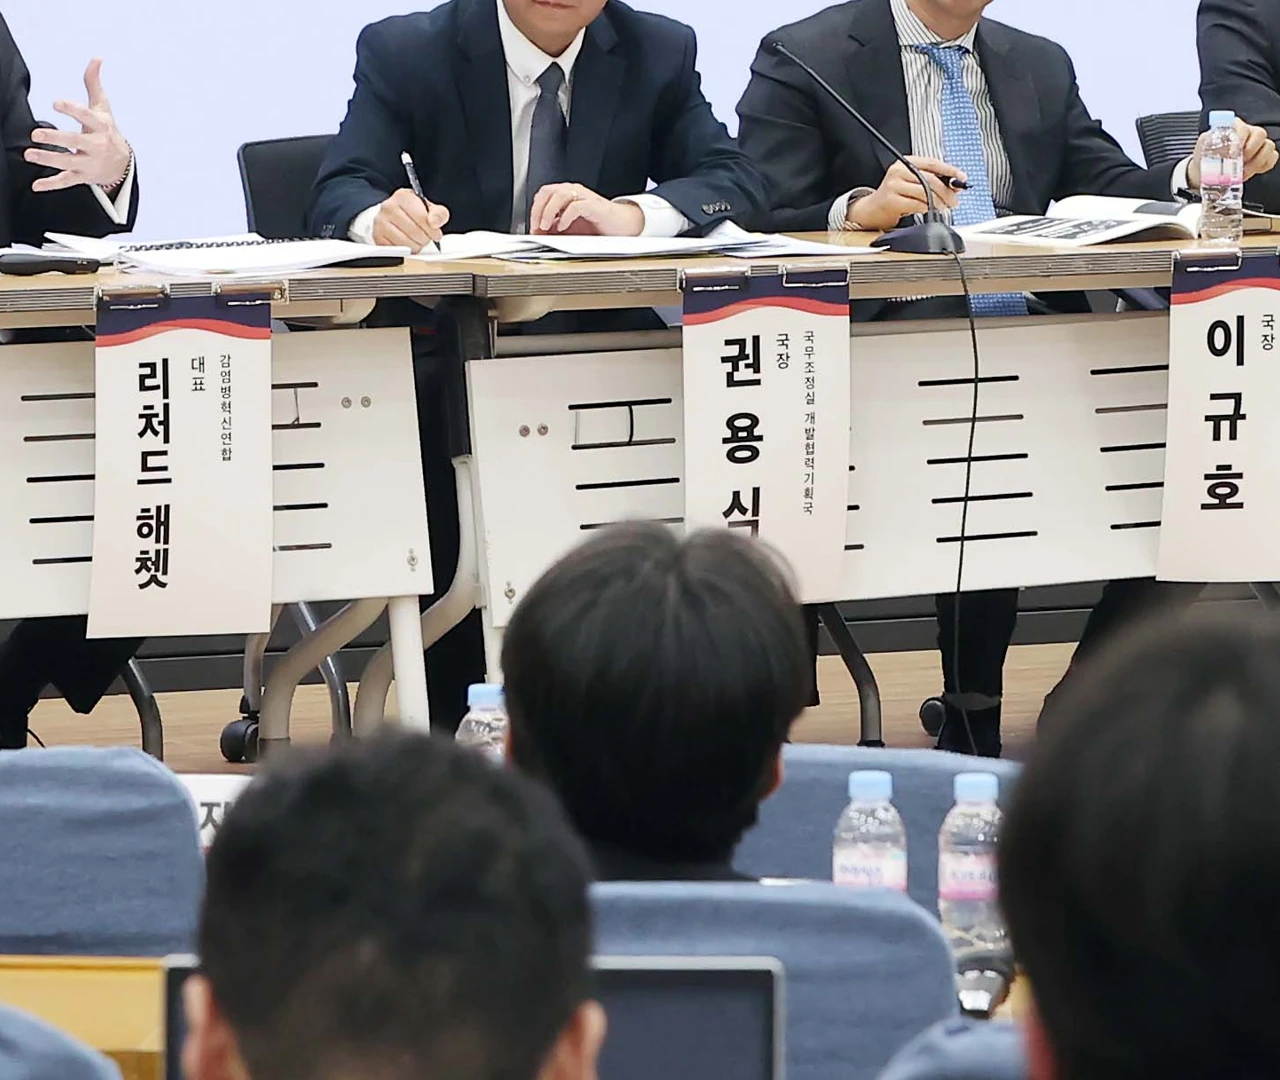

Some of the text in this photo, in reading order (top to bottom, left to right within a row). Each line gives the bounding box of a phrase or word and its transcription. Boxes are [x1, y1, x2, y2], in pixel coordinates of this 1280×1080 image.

[775, 333, 791, 369] 국장
[1260, 313, 1276, 350] 국장
[190, 355, 207, 391] 대표
[219, 353, 233, 461] 감염병혁신연합
[802, 330, 816, 515] 국무조정실 개발협력기획국
[133, 357, 173, 590] 리처드 해쳇
